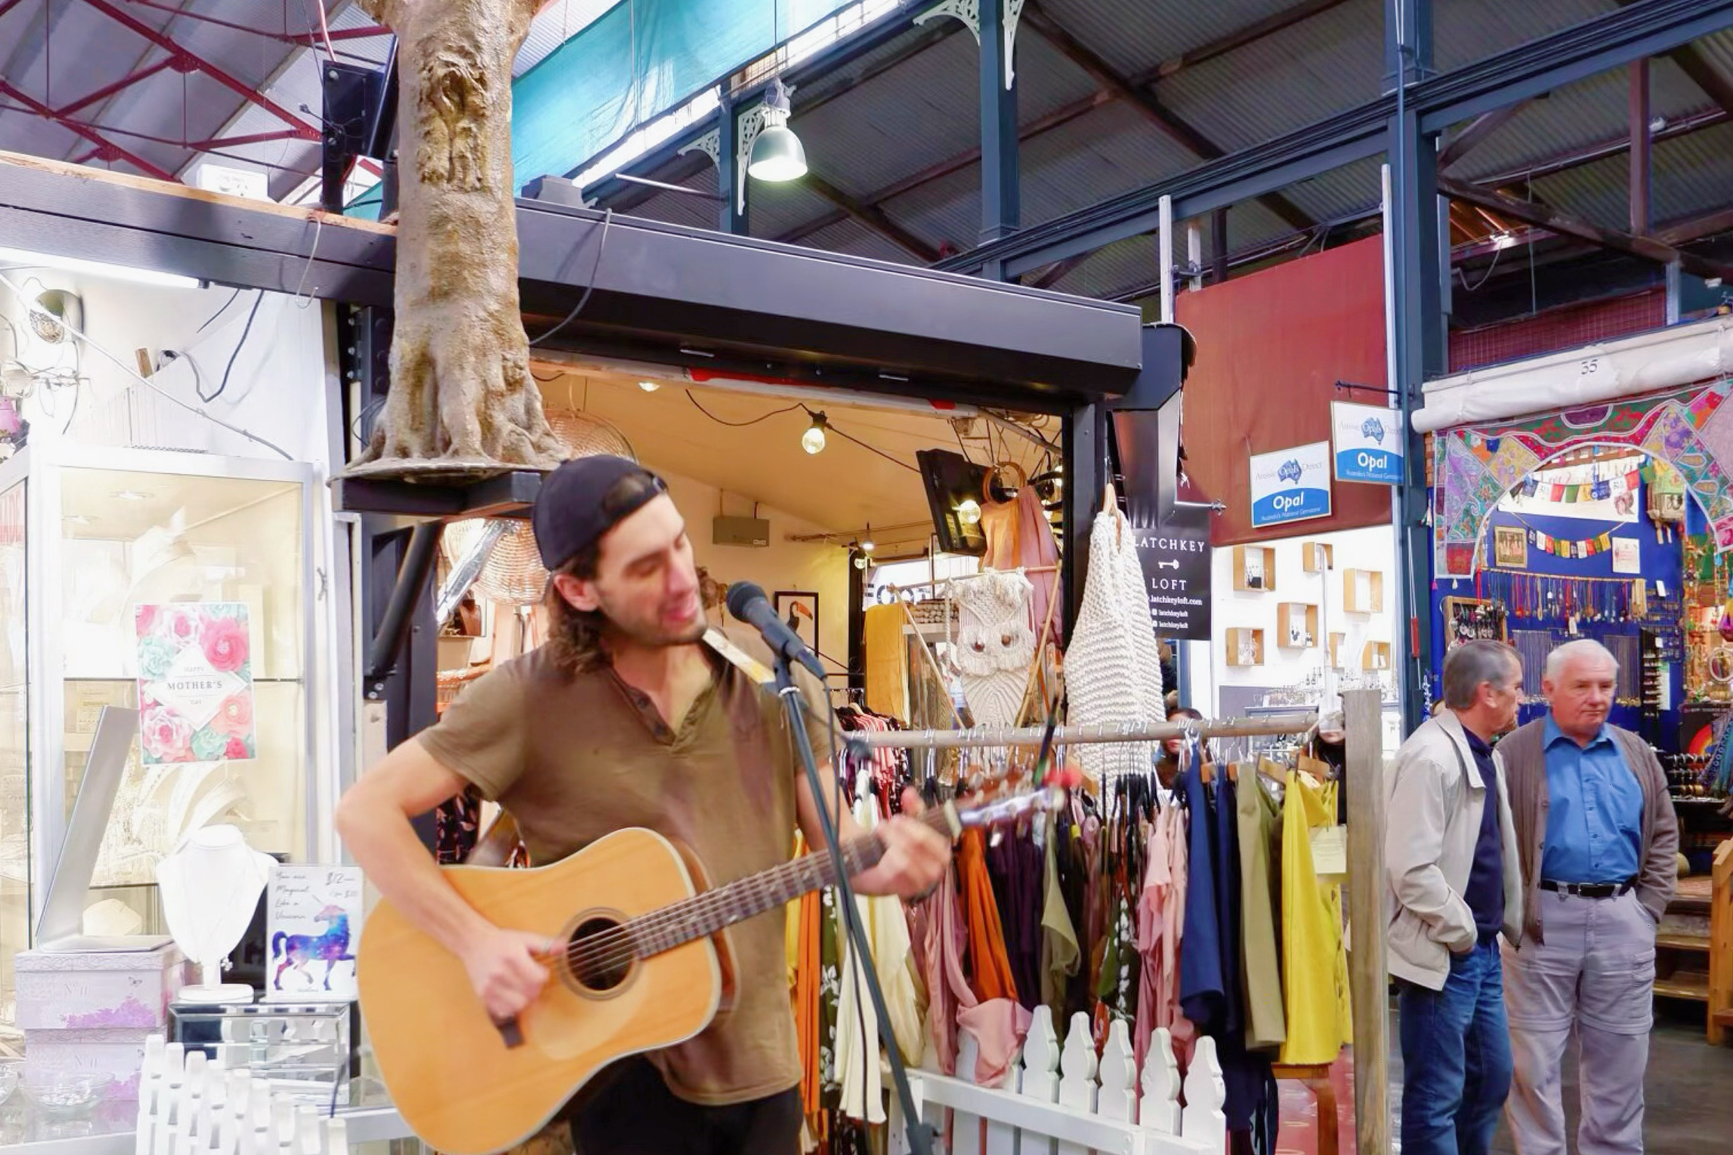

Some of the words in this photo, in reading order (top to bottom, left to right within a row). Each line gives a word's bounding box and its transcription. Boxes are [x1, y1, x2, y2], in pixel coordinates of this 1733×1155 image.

[1357, 452, 1387, 472] Opal
[1273, 491, 1304, 512] Opal
[1152, 577, 1187, 591] LOFT
[167, 680, 223, 691] MOTHER'S
